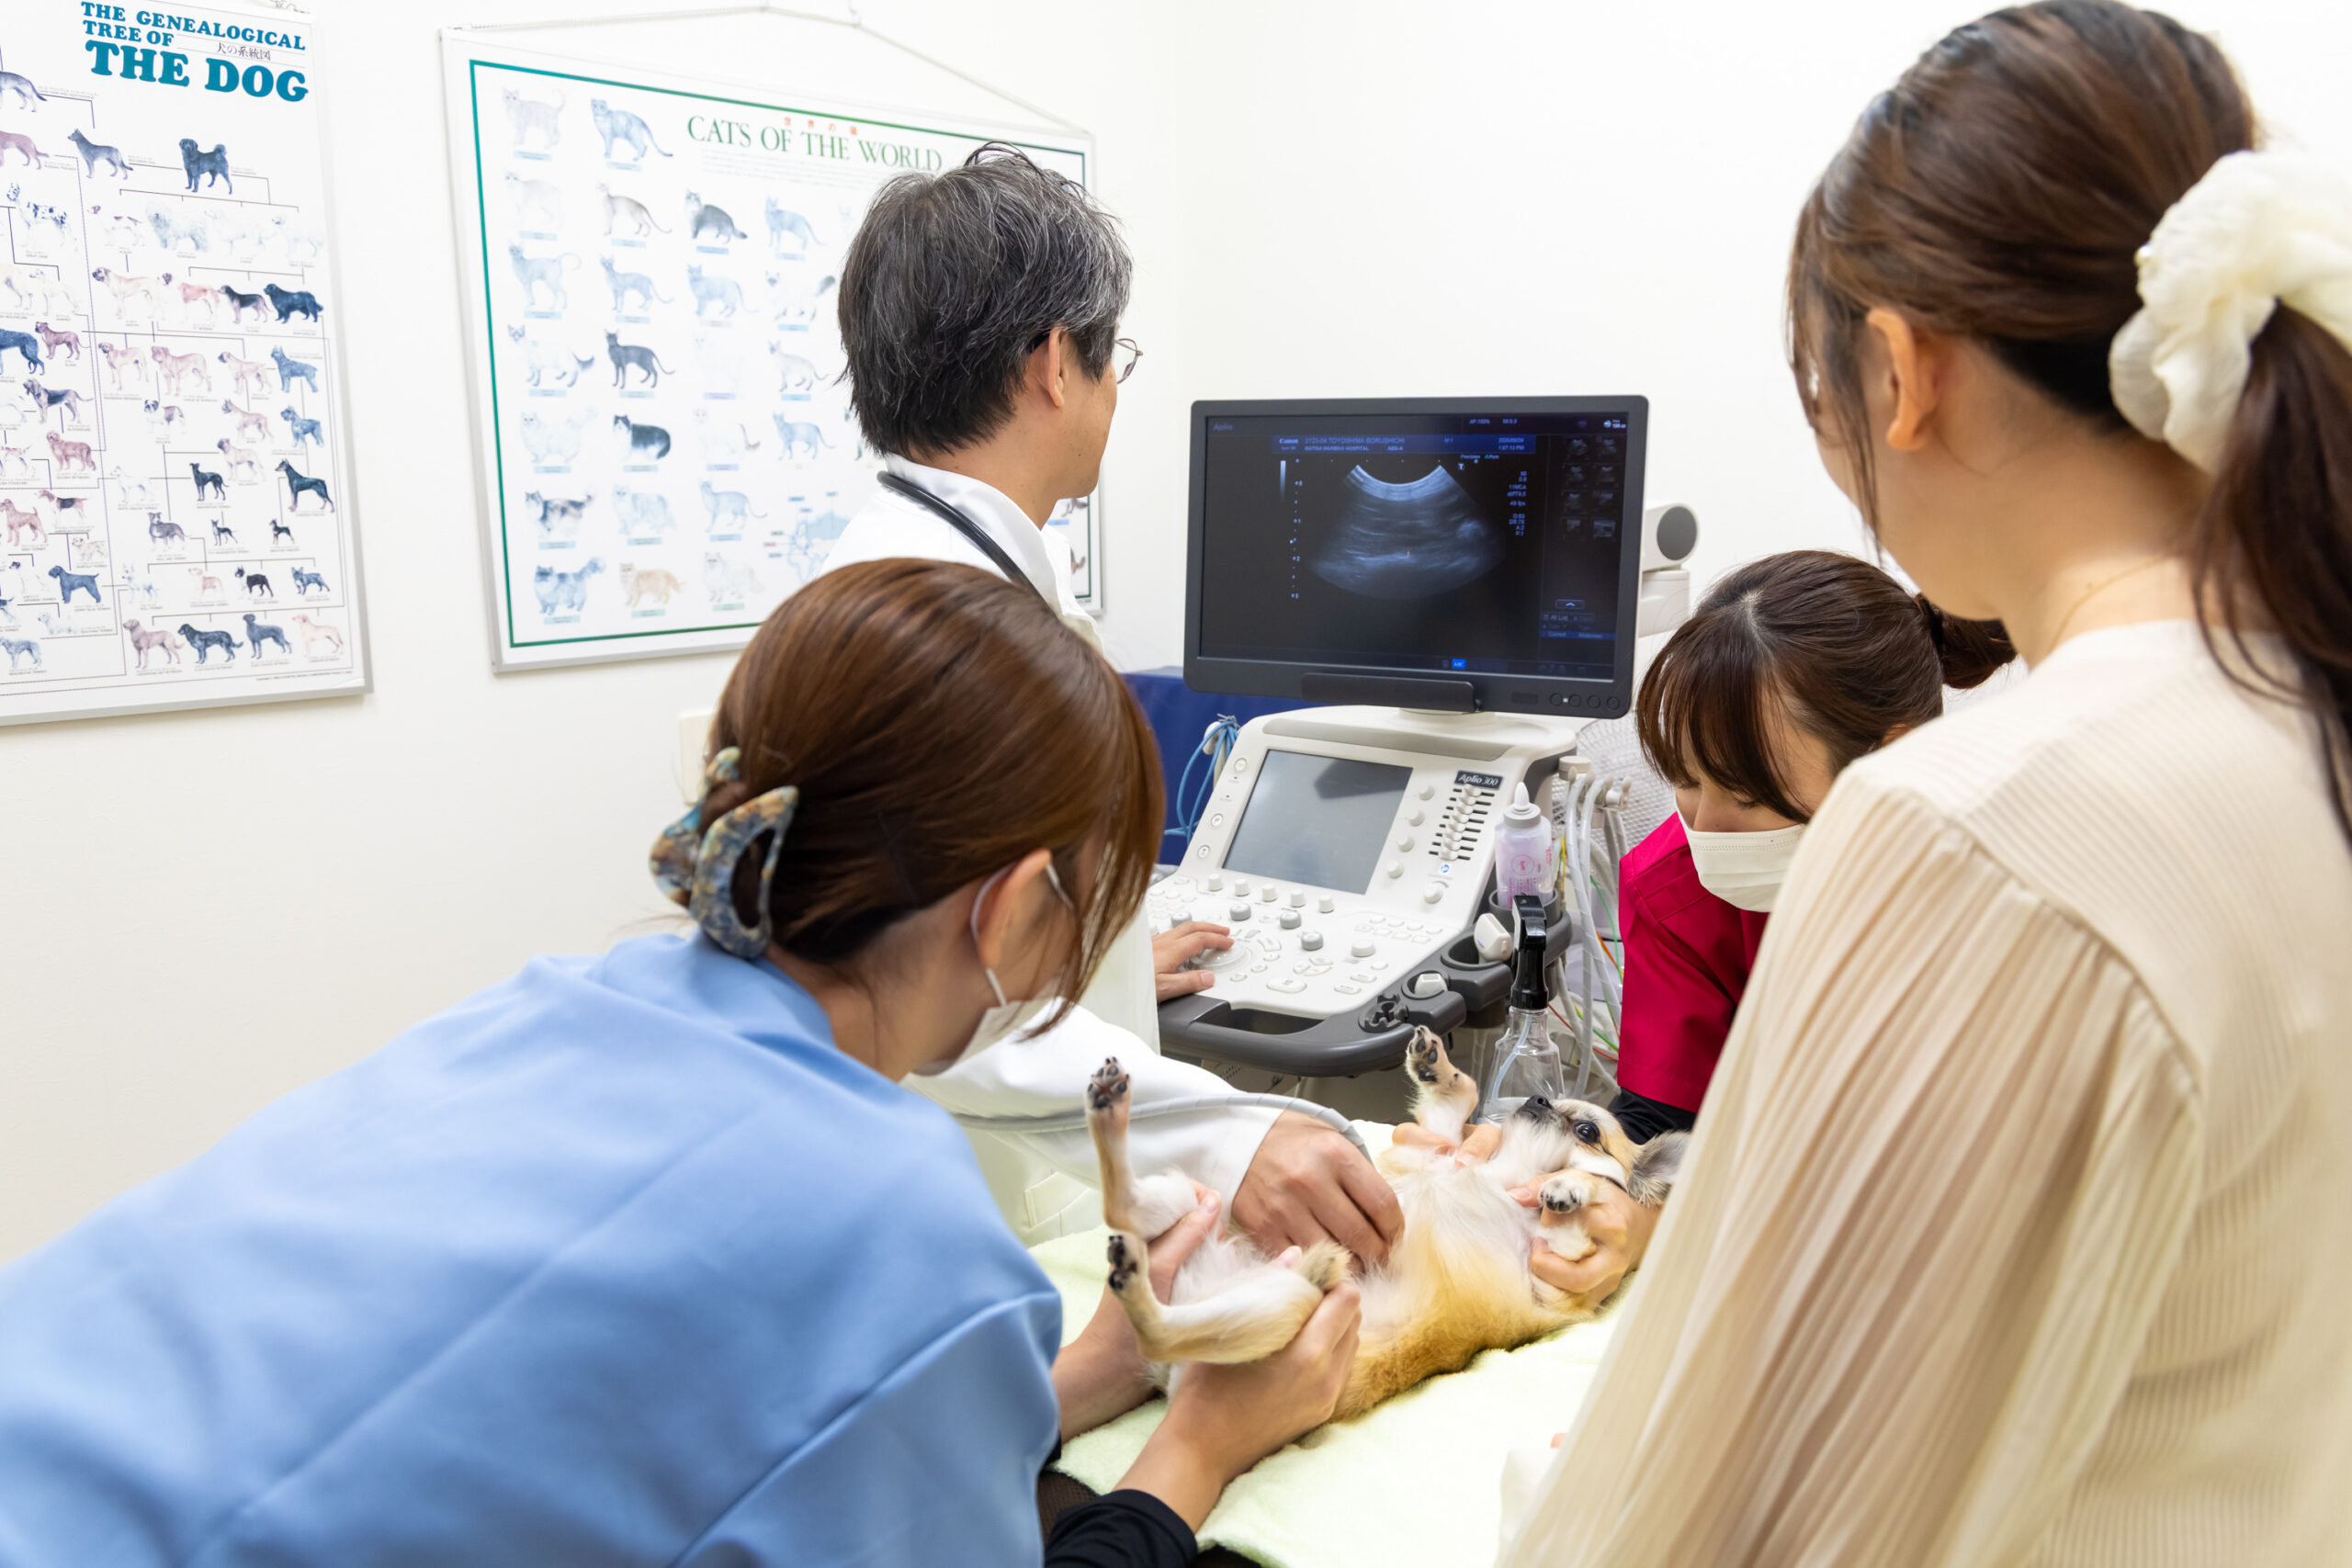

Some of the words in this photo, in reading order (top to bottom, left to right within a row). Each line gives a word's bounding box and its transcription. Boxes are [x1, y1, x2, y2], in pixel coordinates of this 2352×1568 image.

[80, 1, 126, 22] THE
[136, 10, 306, 51] GENEALOGICAL
[82, 19, 142, 43] TREE
[146, 30, 175, 47] OF
[85, 39, 190, 87] THE
[204, 57, 309, 102] DOG
[217, 42, 271, 61] 犬の系統図
[687, 116, 752, 147] CATS
[760, 126, 792, 152] OF
[800, 131, 851, 161] THE
[857, 139, 943, 172] WORLD
[1458, 773, 1483, 784] Aplio
[1482, 776, 1498, 786] 300
